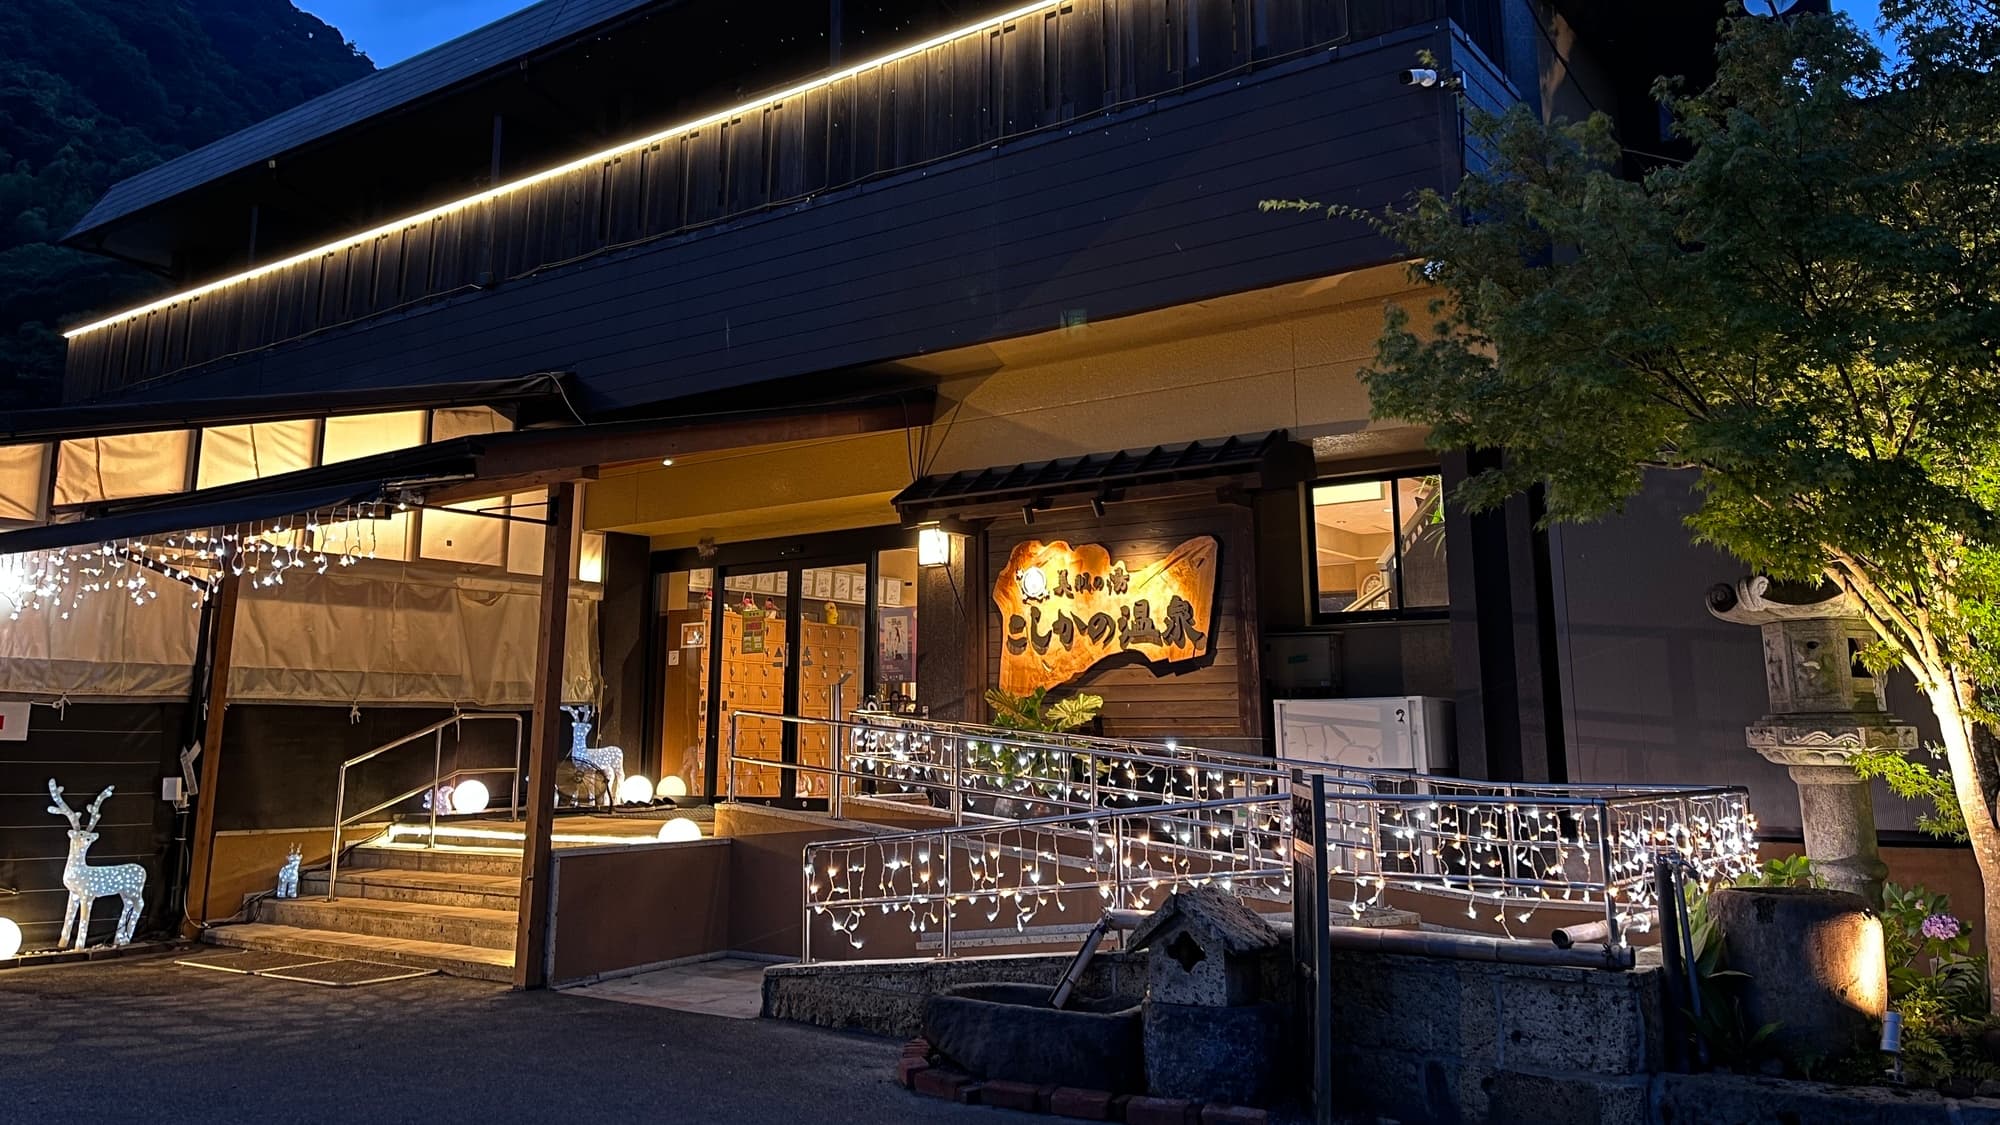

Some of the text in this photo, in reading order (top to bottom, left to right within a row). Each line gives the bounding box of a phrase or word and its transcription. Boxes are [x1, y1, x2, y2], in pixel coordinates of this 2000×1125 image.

[1053, 567, 1130, 598] 美肌の湯
[1007, 595, 1206, 655] こしかの温泉
